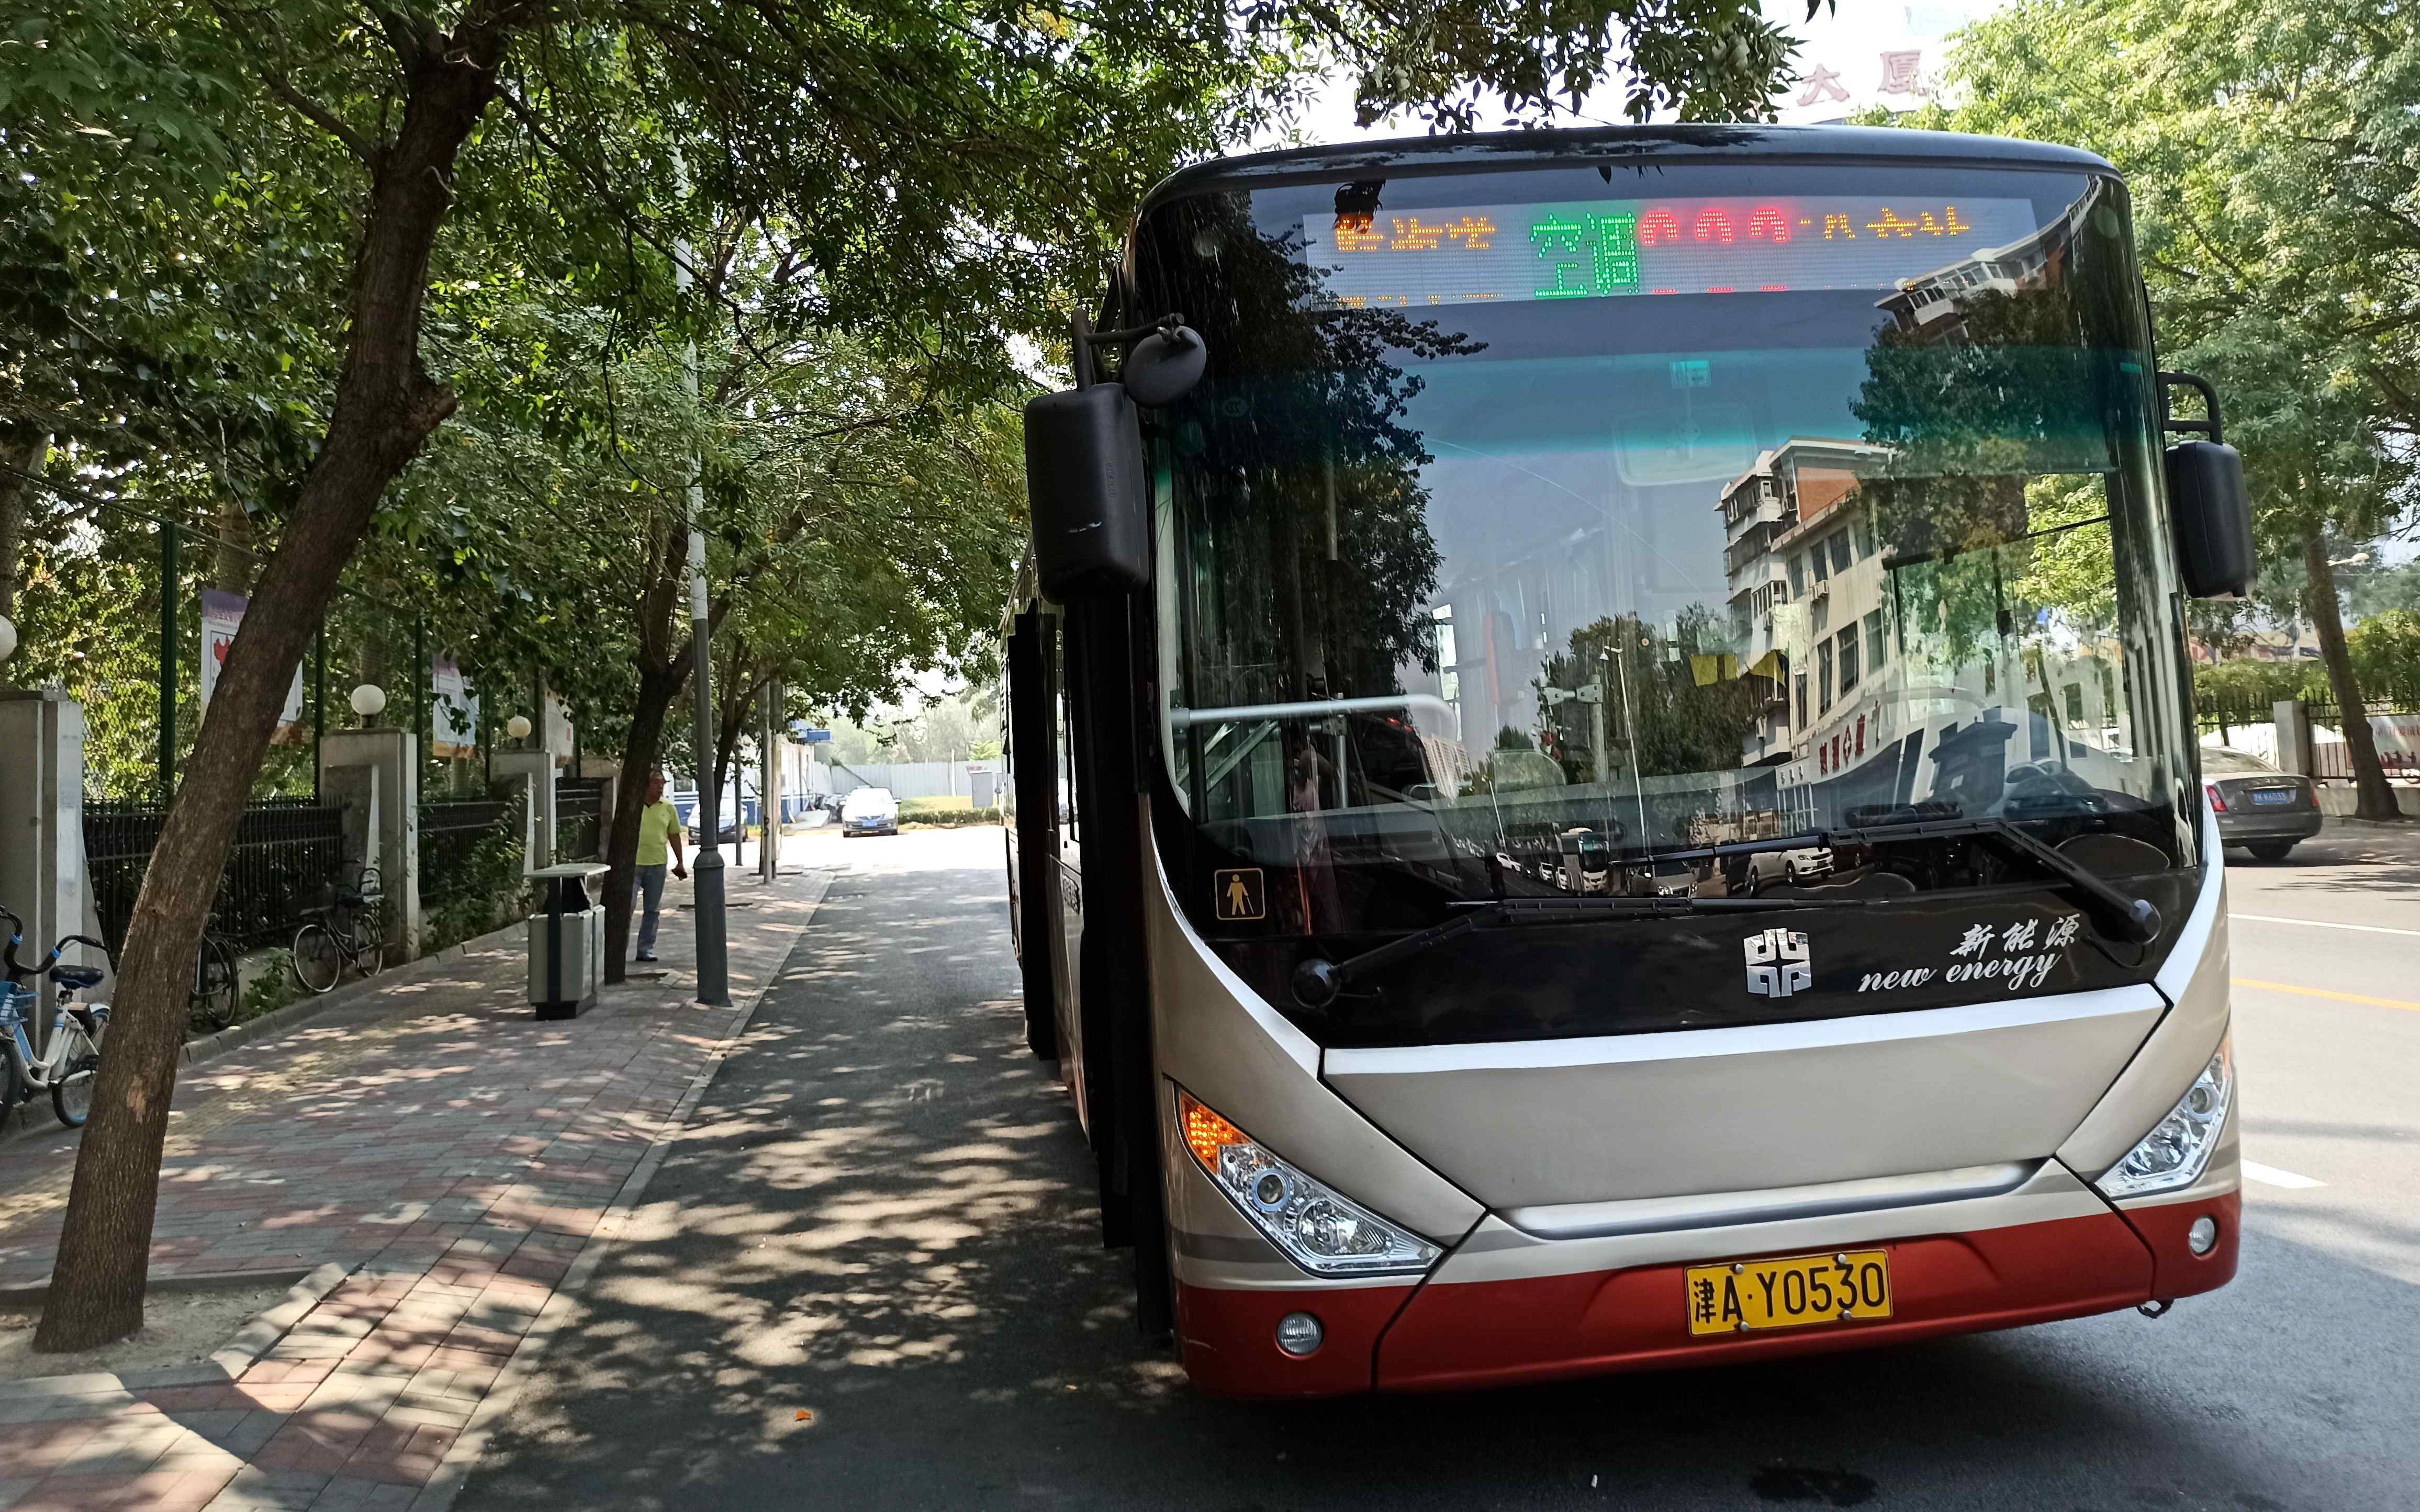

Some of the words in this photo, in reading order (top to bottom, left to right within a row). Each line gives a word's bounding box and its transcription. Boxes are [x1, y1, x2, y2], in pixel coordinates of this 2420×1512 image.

[1797, 50, 1928, 106] 大厦
[1529, 211, 1639, 297] 空调
[1950, 913, 2080, 960] 新能源
[1857, 968, 1937, 992] new
[1946, 952, 2063, 990] energy
